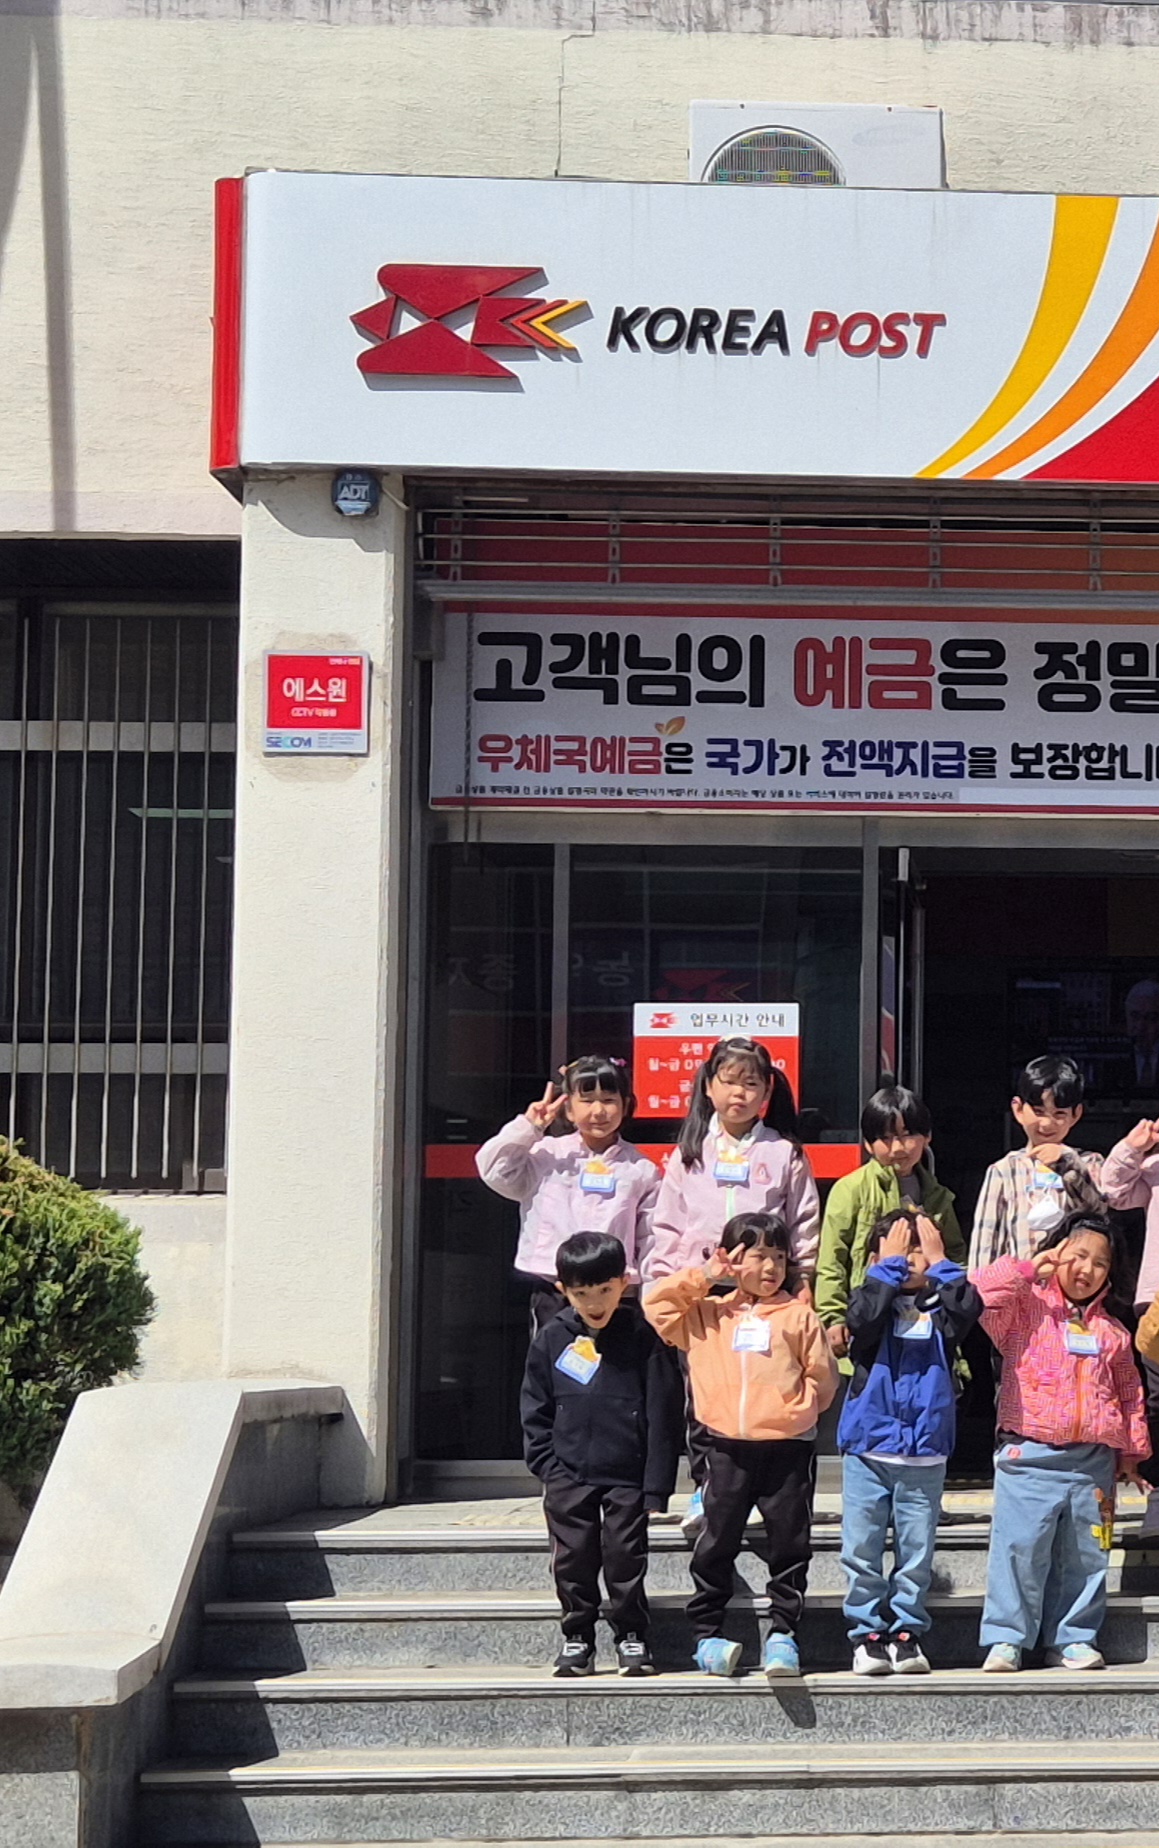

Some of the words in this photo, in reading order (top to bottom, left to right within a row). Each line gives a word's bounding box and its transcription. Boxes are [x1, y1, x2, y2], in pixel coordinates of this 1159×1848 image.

[607, 306, 790, 356] KOREA
[804, 312, 947, 357] POST
[338, 484, 369, 500] ADT
[473, 630, 767, 708] 고객님의
[792, 635, 1009, 712] 예금은
[282, 677, 348, 703] 에스원
[476, 732, 694, 776] 우체국예금은
[705, 737, 811, 777] 국가가
[821, 739, 998, 779] 전액지급을
[689, 1012, 749, 1029] 업무시간
[756, 1012, 786, 1029] 안내
